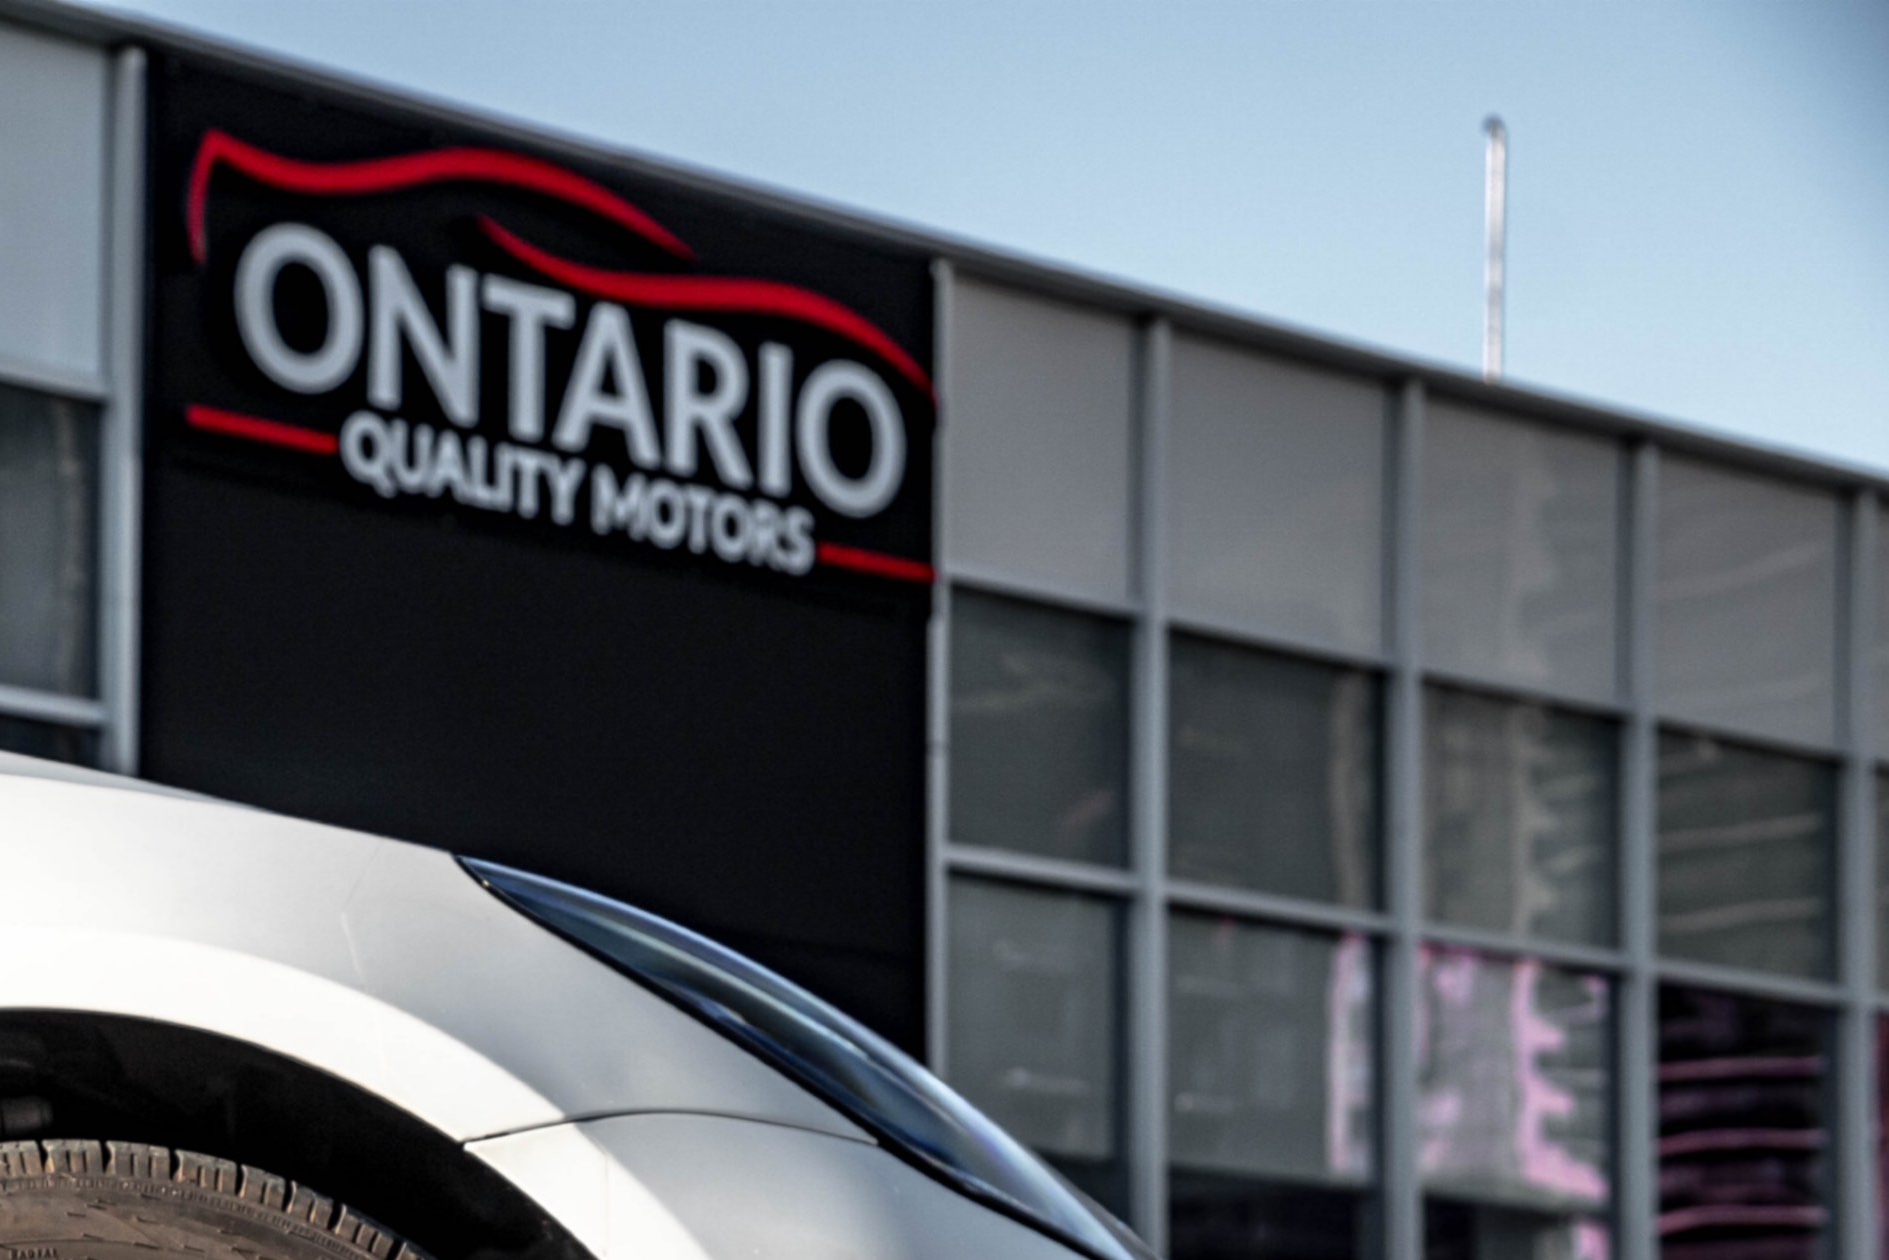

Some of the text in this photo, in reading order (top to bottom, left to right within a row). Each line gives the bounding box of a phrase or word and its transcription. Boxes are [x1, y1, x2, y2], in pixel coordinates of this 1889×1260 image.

[234, 222, 905, 518] ONTARIO
[340, 410, 815, 574] QUALITY MOTORS
